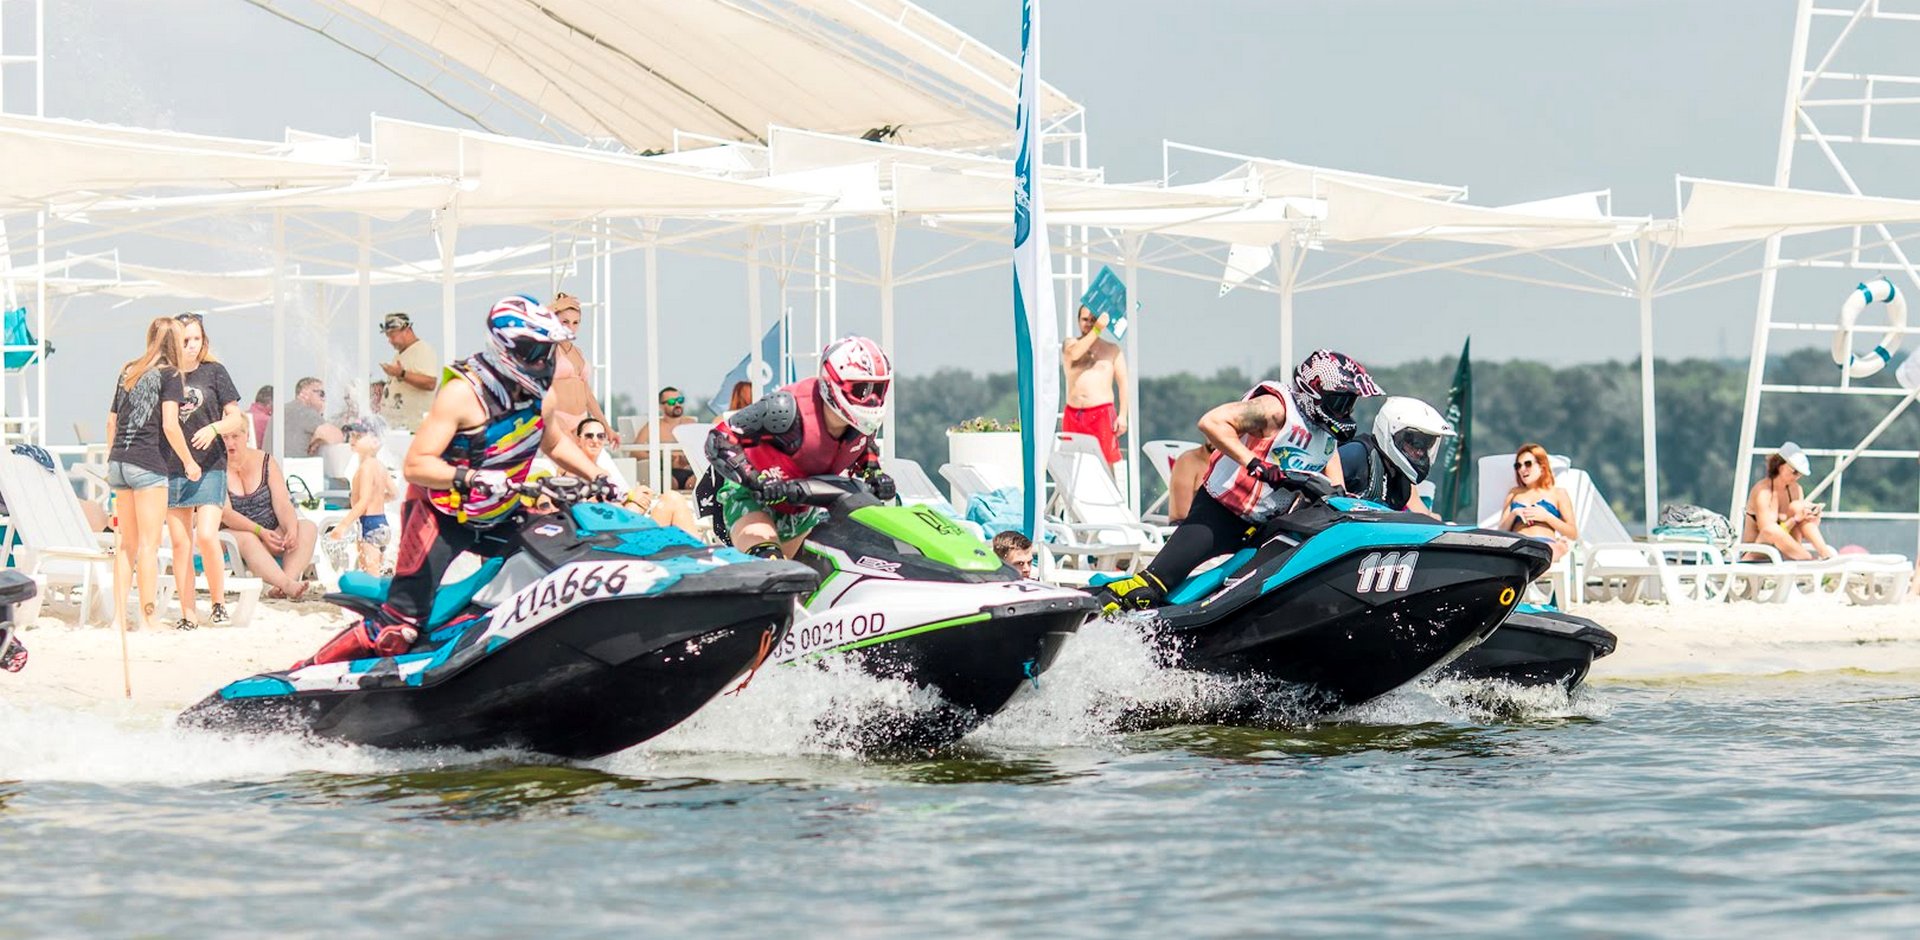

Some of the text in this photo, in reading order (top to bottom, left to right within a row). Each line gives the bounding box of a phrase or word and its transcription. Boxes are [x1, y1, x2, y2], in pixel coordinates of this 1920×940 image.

[1356, 550, 1420, 594] 111
[800, 618, 844, 650] 0021
[851, 612, 886, 637] OD
